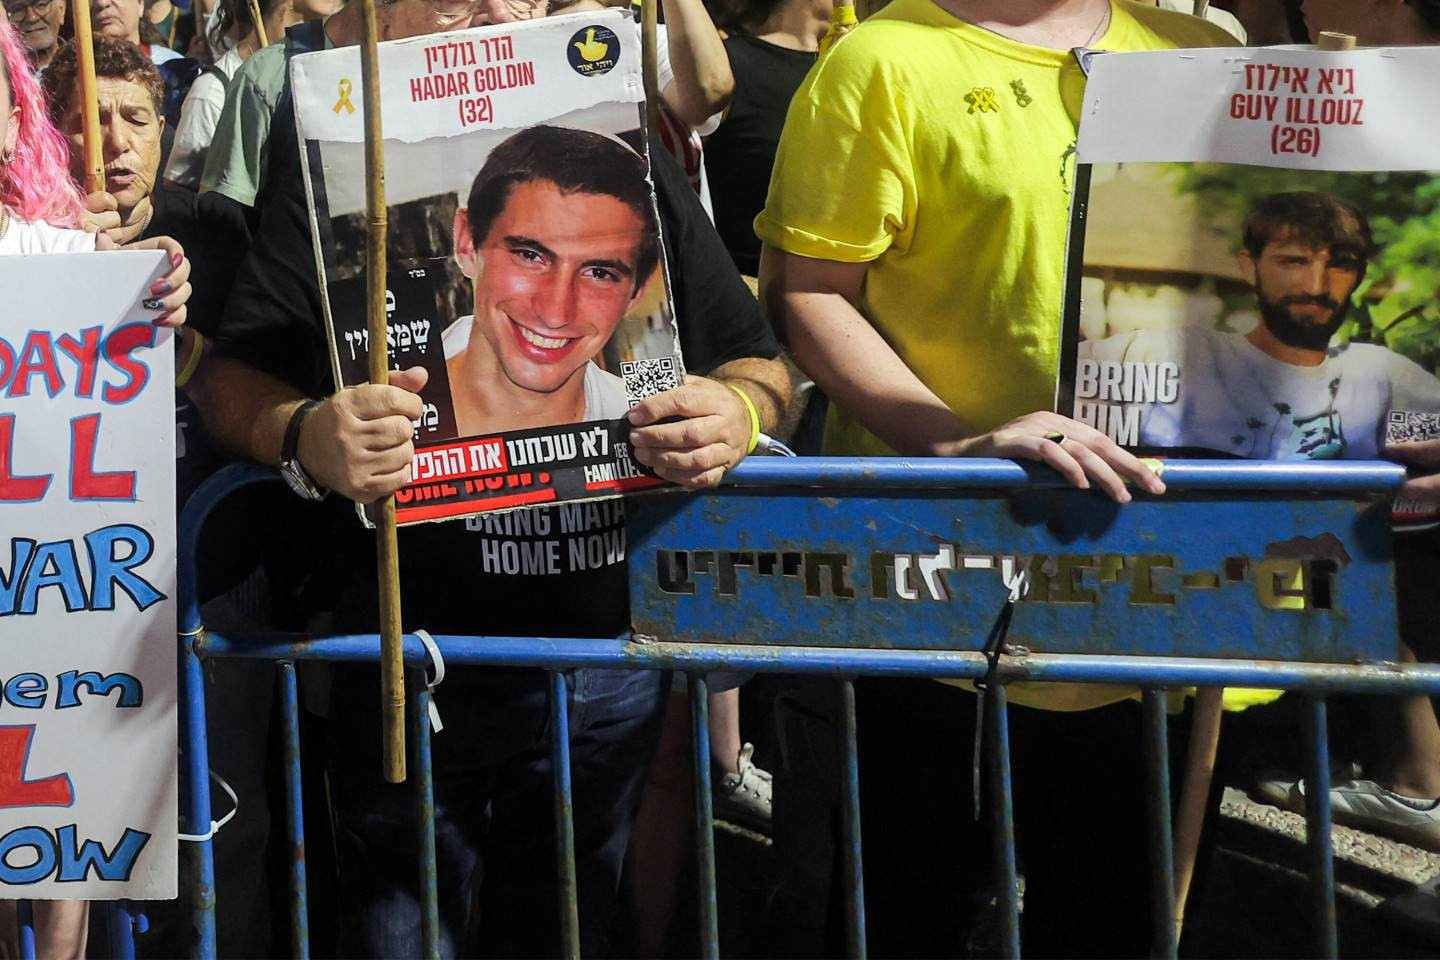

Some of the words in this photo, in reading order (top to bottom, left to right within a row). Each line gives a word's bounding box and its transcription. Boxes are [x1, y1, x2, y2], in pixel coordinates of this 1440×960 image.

[424, 39, 477, 74] גולדין
[479, 34, 514, 63] הדר
[410, 71, 471, 103] HADAR
[474, 60, 536, 91] GOLDIN
[1244, 63, 1310, 94] אילוז
[1317, 68, 1354, 94] גיא
[458, 95, 494, 128] (32)
[1230, 93, 1278, 122] GUY
[1285, 95, 1364, 125] ILLOUZ
[1271, 125, 1320, 157] (26)
[1077, 360, 1181, 404] BRING
[581, 426, 609, 458] לא
[1073, 404, 1142, 448] HIM
[469, 441, 502, 471] את
[506, 432, 578, 466] שכחנו
[481, 539, 561, 575] HOME
[569, 527, 627, 571] NOW
